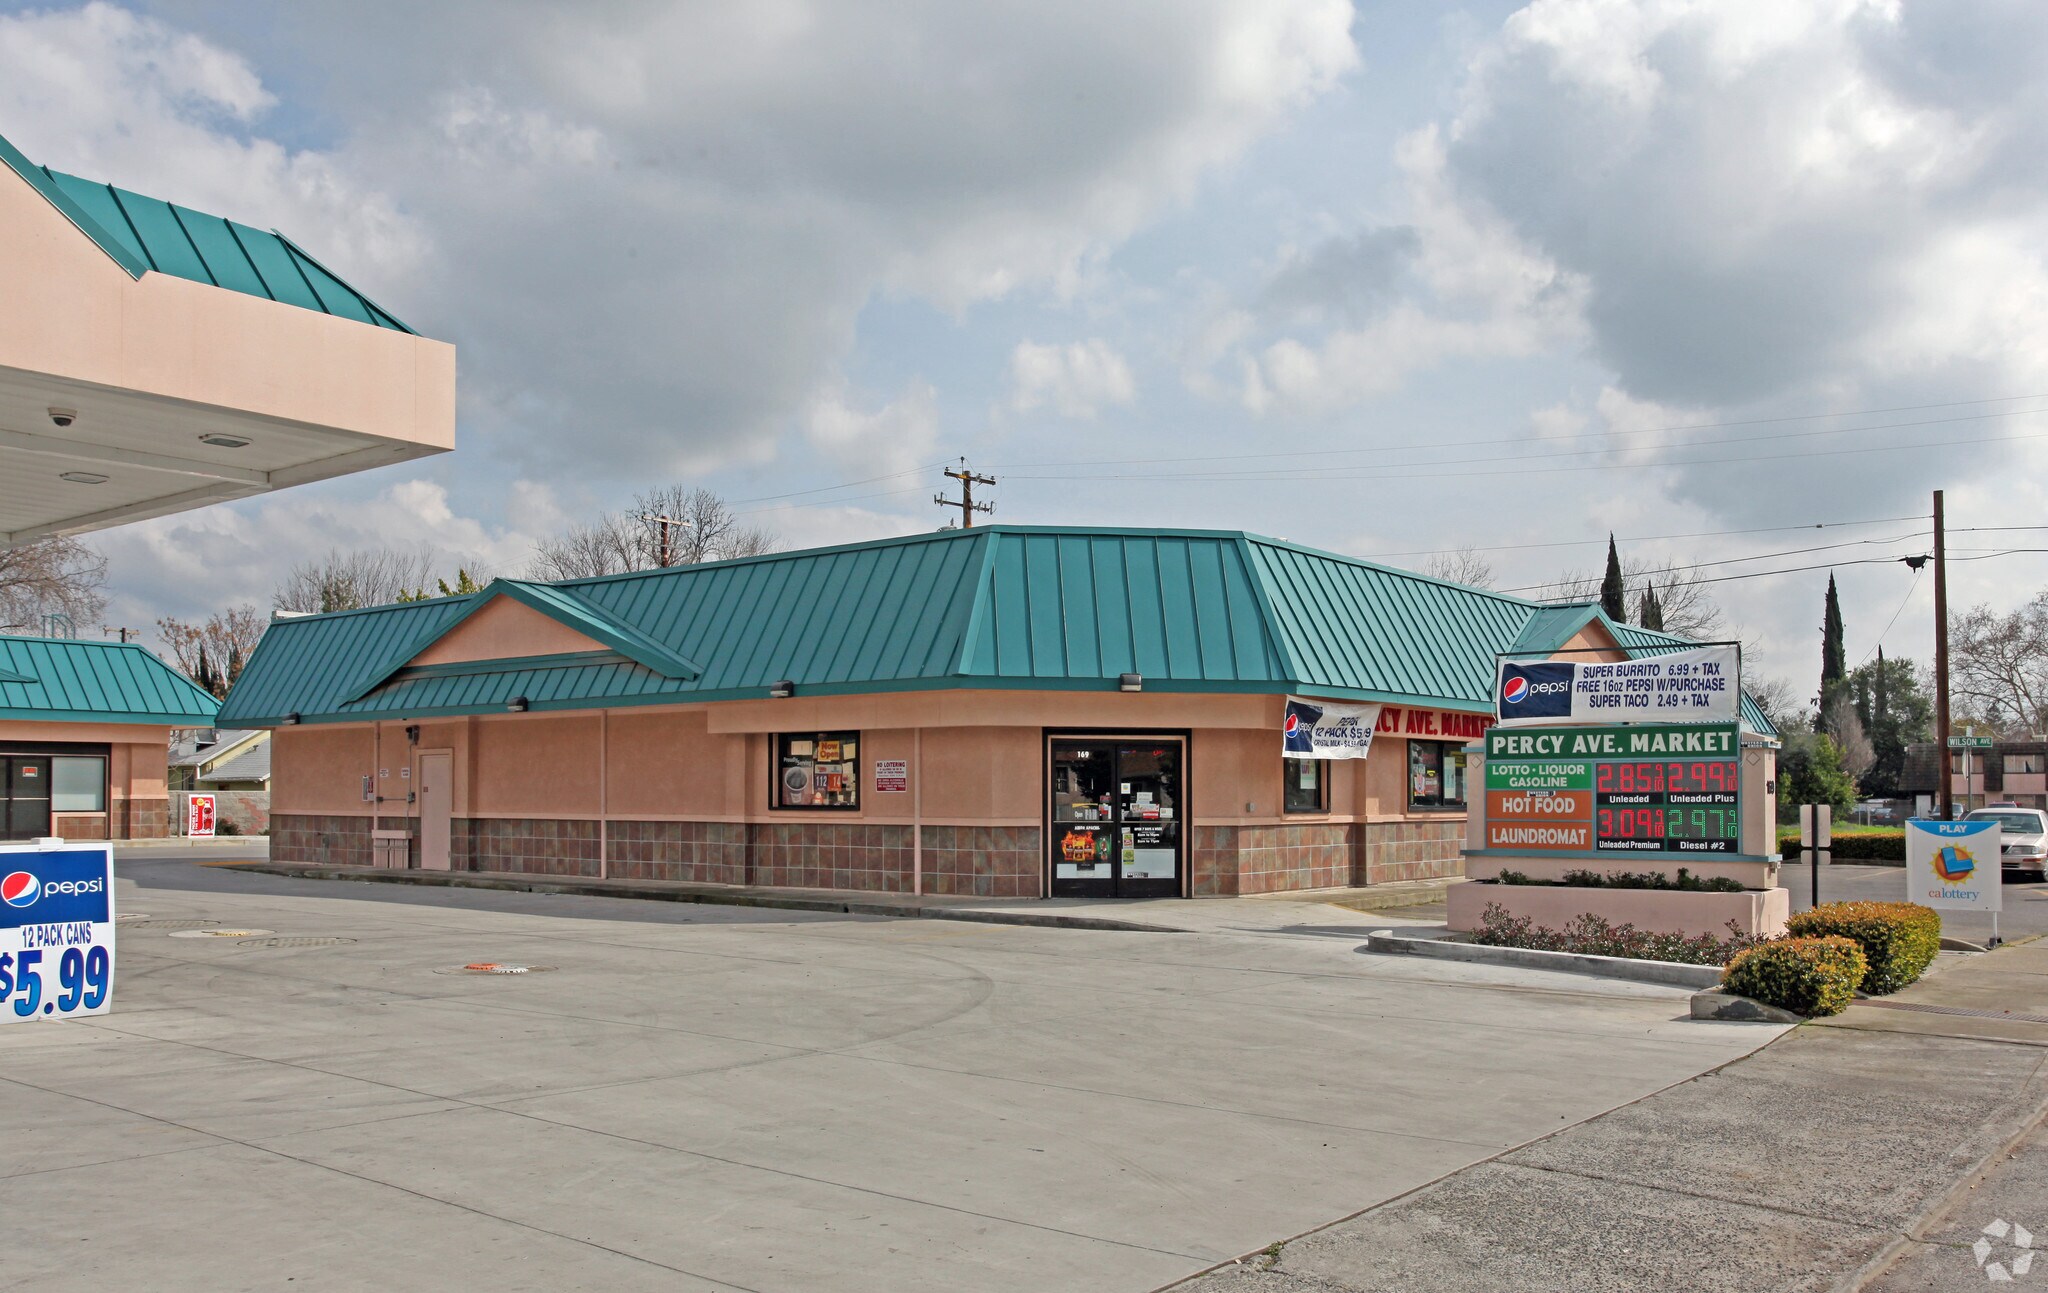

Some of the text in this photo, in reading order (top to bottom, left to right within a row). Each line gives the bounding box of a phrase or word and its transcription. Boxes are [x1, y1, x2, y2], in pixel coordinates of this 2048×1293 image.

[1583, 666, 1613, 678] SUPER
[1616, 664, 1660, 677] BURRITO
[1668, 663, 1689, 676] 6.99
[1702, 662, 1720, 676] TAX
[1530, 680, 1569, 696] pepsi
[1576, 680, 1600, 692] FREE
[1626, 678, 1654, 692] PEPSI
[1656, 678, 1725, 691] W/PURCHASE
[1590, 695, 1621, 708] SUPER
[1624, 694, 1649, 707] TACO
[1657, 694, 1678, 707] 2.49
[1692, 694, 1710, 706] TAX
[1406, 710, 1438, 735] AVE.
[1315, 728, 1324, 737] 12
[1325, 728, 1347, 738] PACK
[1493, 732, 1732, 754] PERCY AVE. MARKET
[820, 751, 838, 759] Open
[1492, 765, 1585, 776] LOTTO LIQUOR
[1510, 777, 1568, 787] GASOLINE
[1503, 798, 1575, 813] HOT FOOD
[1492, 828, 1586, 845] LAUNDROMAT
[44, 877, 102, 898] pepsi
[1929, 888, 1979, 901] calottery
[22, 923, 91, 948] 12 PACK CANS
[0, 946, 109, 1017] $5.99
